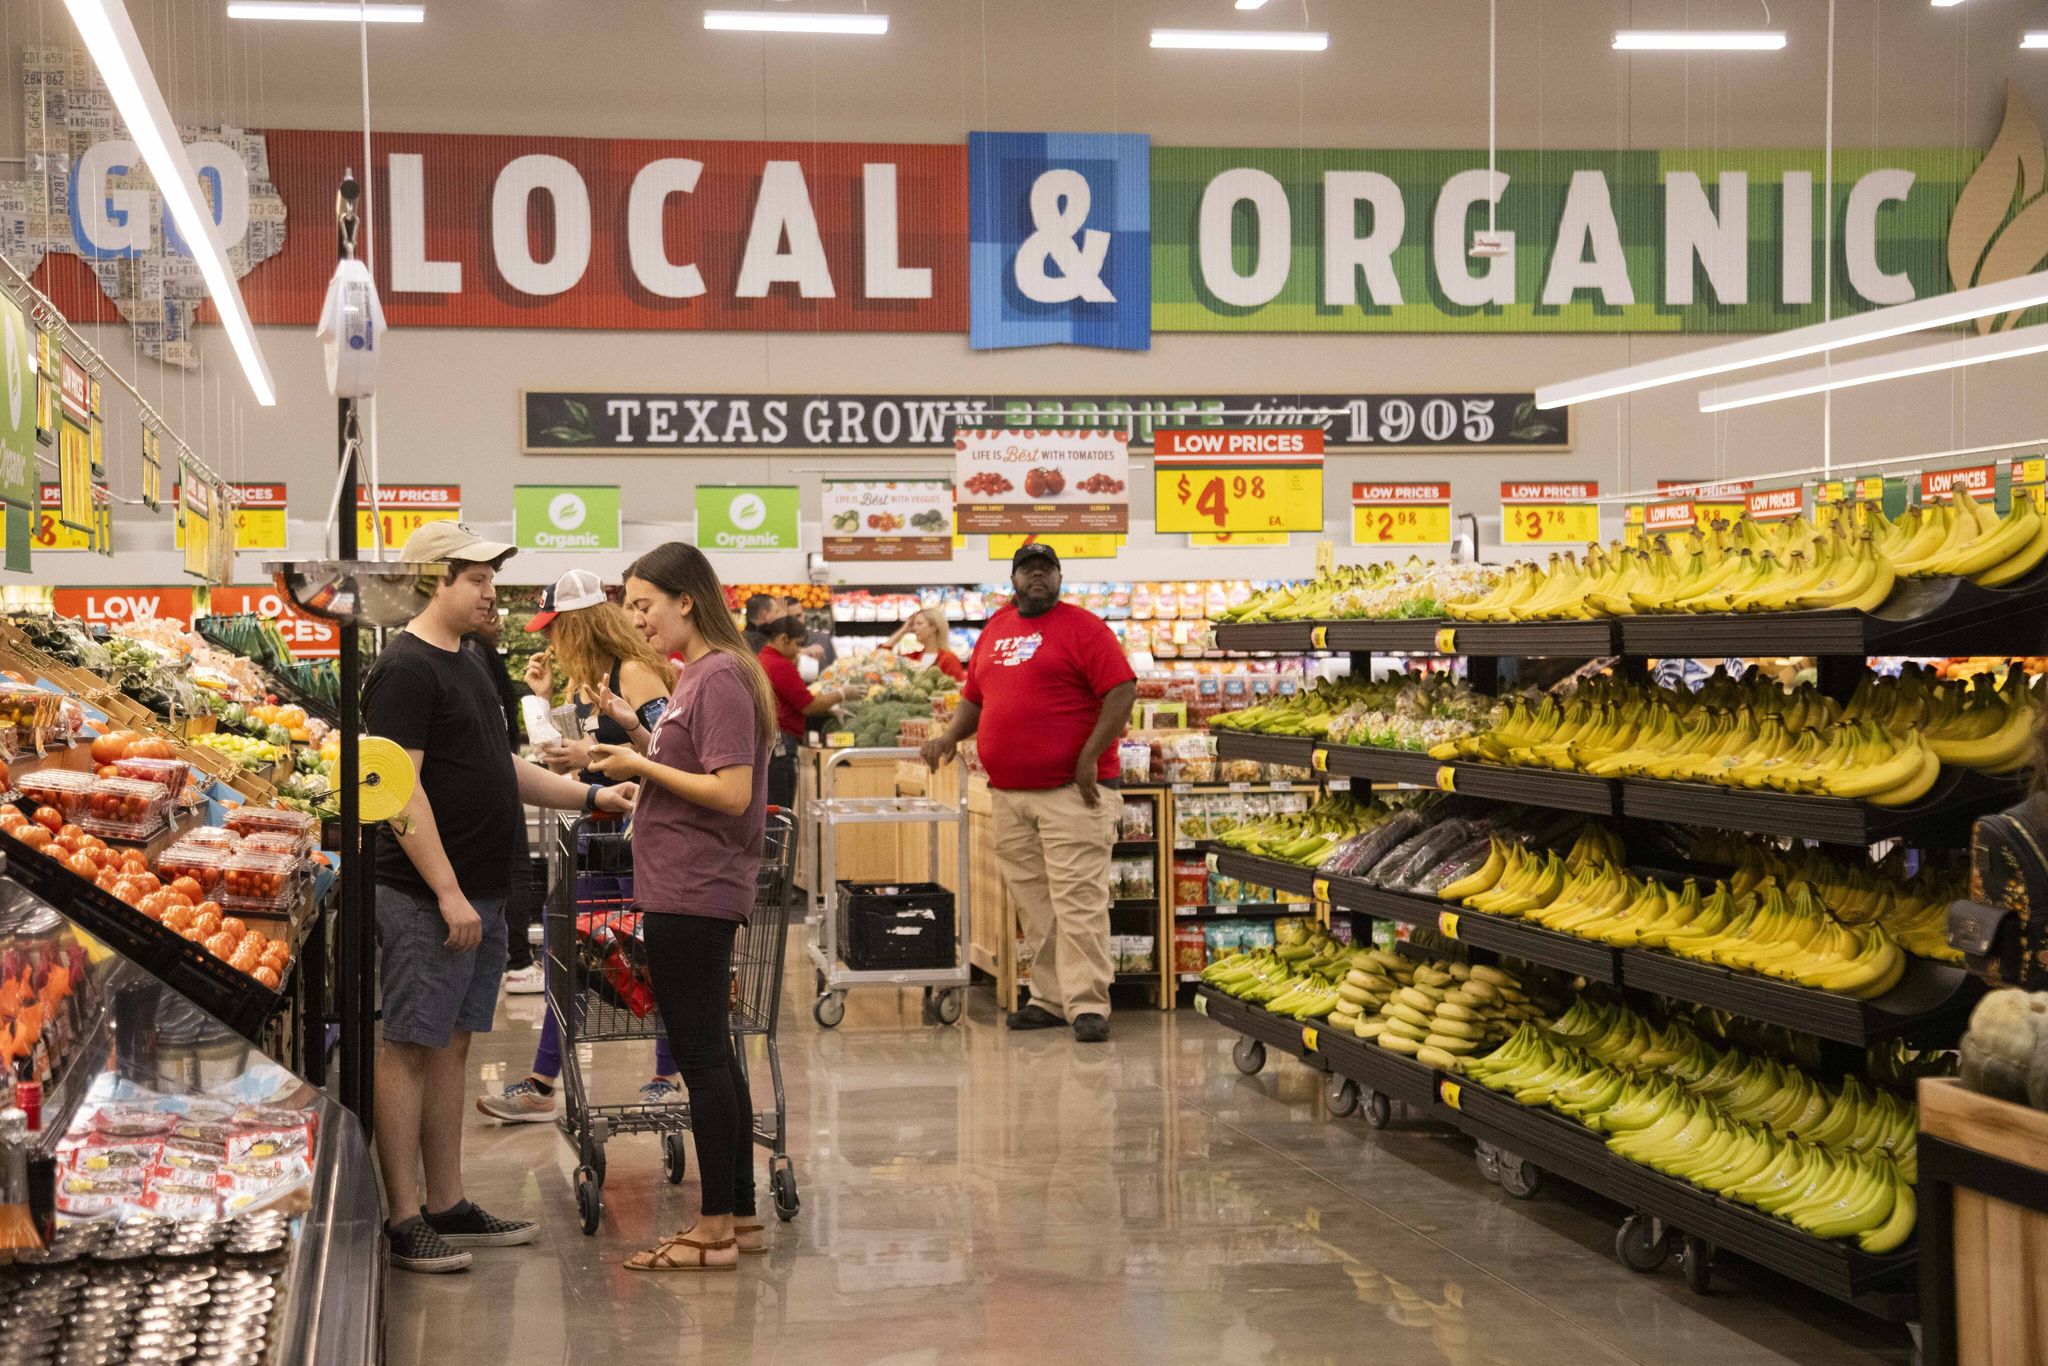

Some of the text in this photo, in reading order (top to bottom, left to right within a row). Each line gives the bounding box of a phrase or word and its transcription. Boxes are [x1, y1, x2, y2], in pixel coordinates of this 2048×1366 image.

[78, 140, 1916, 307] GO LOCAL & ORGANIC
[607, 400, 788, 443] TEXAS
[1346, 399, 1495, 442] 1905
[1174, 434, 1304, 453] LOW PRICES
[972, 445, 1115, 463] LIFE IS Best WITH TOMATOES
[1363, 486, 1440, 499] LOW PRICES
[1512, 486, 1588, 498] LOW PRICES
[1929, 475, 1951, 493] LOW
[399, 489, 449, 501] PRICES
[1751, 491, 1796, 511] LOW PRICES
[1650, 503, 1689, 522] LOW PRICES
[535, 531, 601, 548] Organic
[716, 531, 779, 548] Organic
[87, 596, 160, 620] LOW
